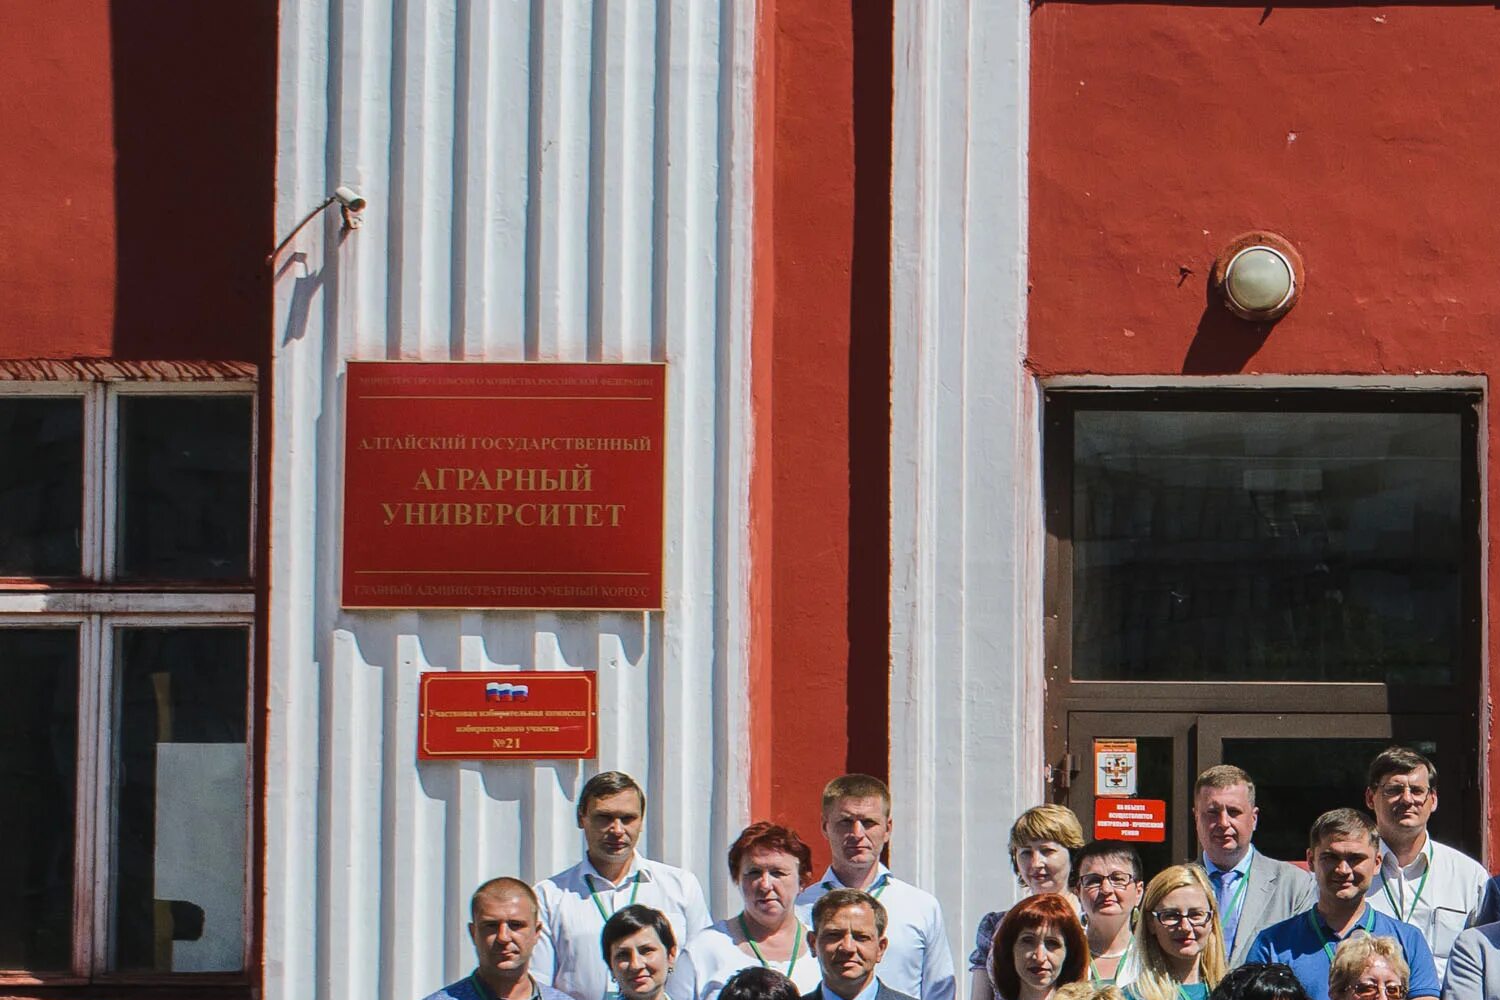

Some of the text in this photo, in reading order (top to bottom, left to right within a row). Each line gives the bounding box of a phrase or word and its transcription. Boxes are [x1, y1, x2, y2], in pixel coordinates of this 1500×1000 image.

[359, 434, 651, 452] АЛТАЙСКИЙ ГОСУДАРСТВЕННЫЙ
[414, 464, 593, 492] АГРАРНЫЙ
[382, 504, 626, 527] УНИВЕРСИТЕТ
[354, 584, 649, 598] ГЛАВНЫЙ АДМИНИСТРАТИВНО-УЧЕБНЫЙ КОРПУС
[493, 738, 520, 749] №21
